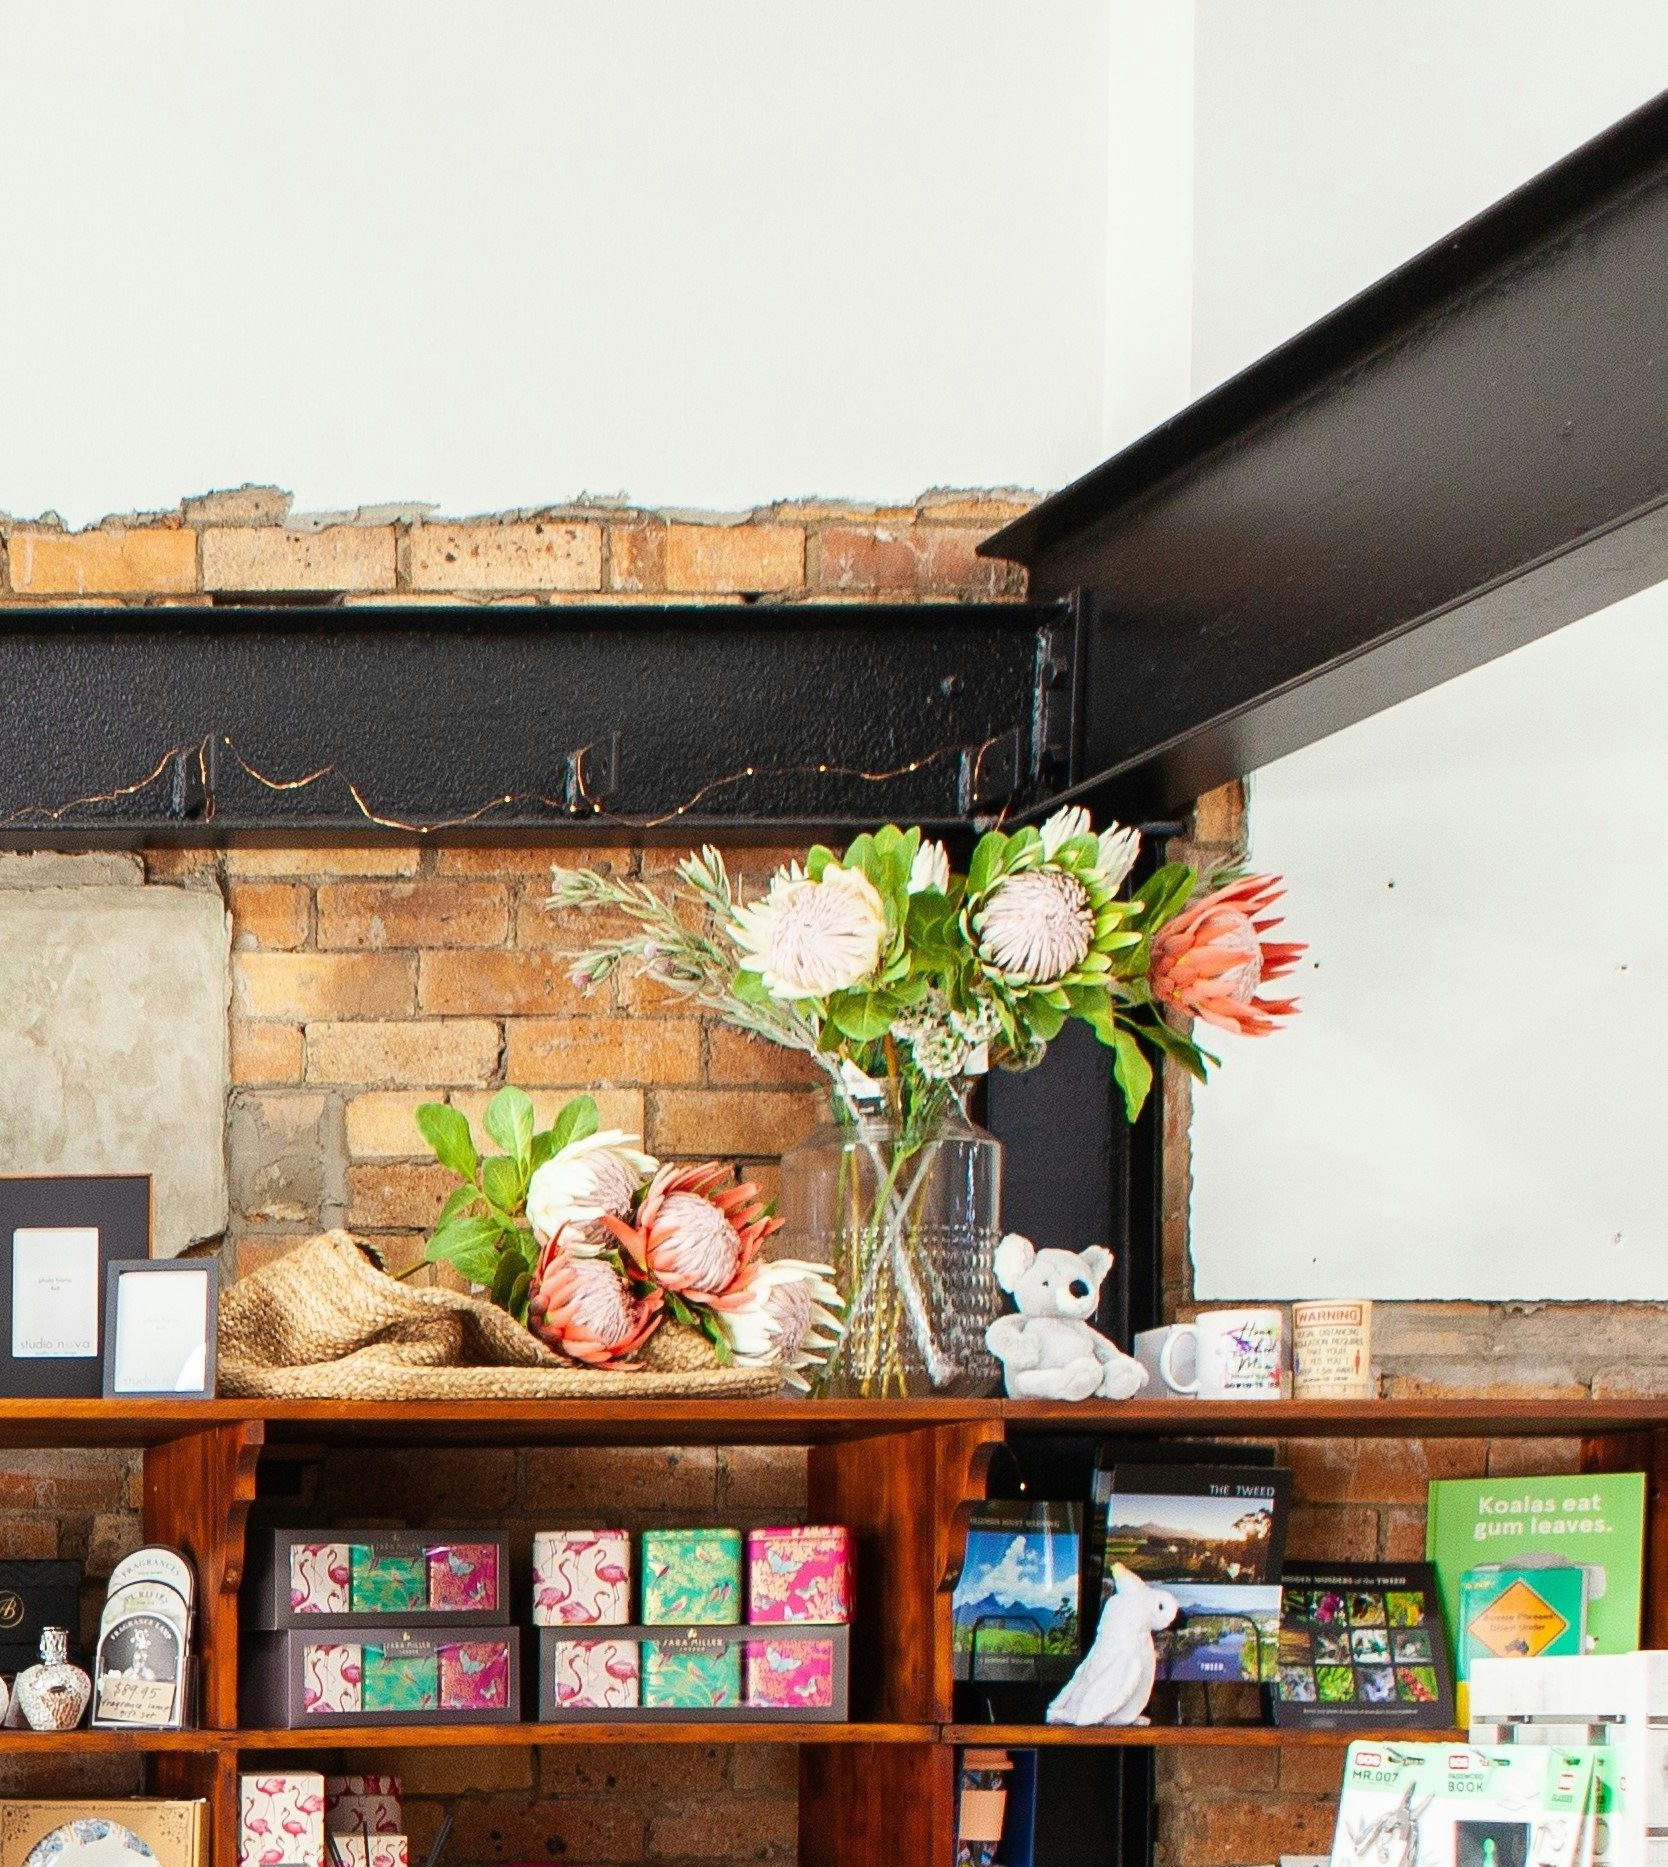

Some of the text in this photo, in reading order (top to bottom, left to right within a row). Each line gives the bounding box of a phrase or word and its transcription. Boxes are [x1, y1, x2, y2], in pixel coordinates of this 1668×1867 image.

[20, 1337, 53, 1350] studio
[1210, 1485, 1275, 1498] THE TWEED
[1479, 1494, 1603, 1515] Koalas eat
[1474, 1517, 1612, 1541] gum leaves.
[121, 1559, 181, 1578] FRAGRANCES
[110, 1618, 173, 1641] FRAGRANCE LAMP
[114, 1681, 162, 1700] $89.95
[1352, 1770, 1399, 1784] MR.007
[1448, 1781, 1484, 1793] BOOK
